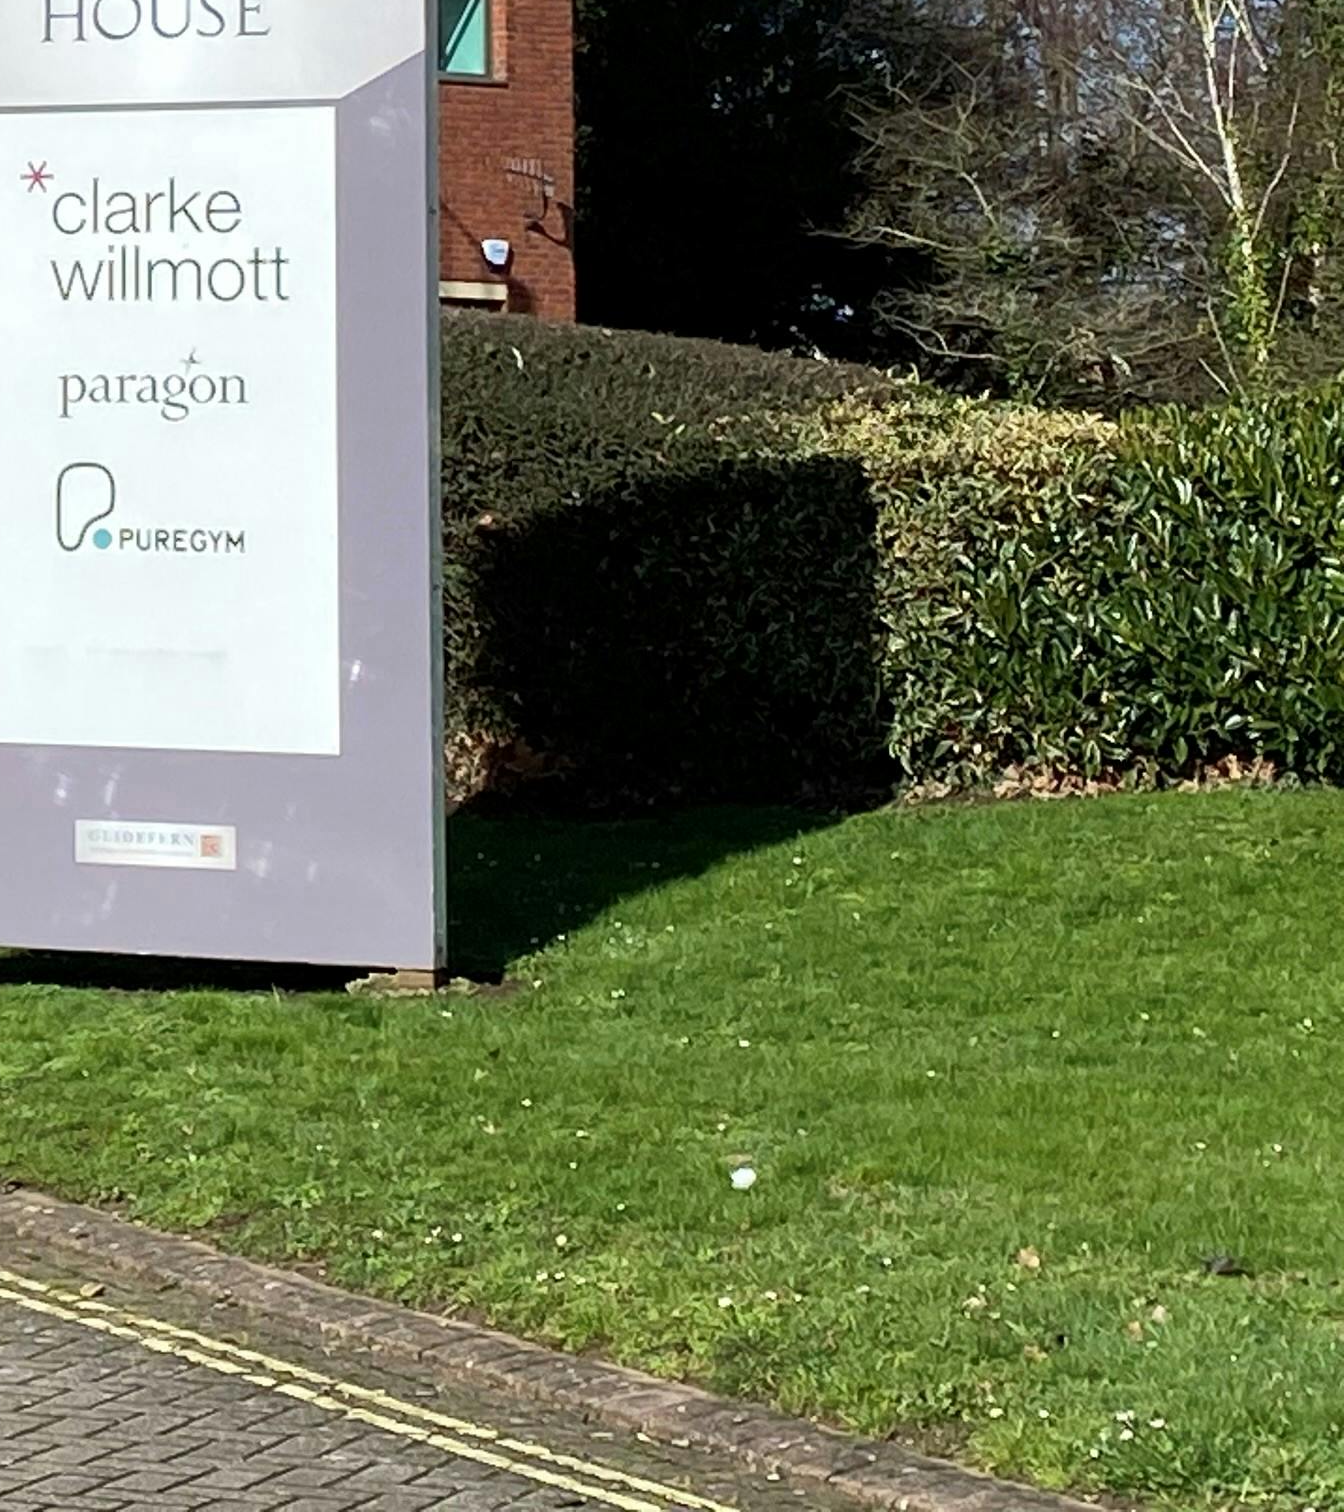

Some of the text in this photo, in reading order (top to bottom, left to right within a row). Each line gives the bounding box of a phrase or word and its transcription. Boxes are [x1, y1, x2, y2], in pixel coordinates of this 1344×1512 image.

[51, 177, 242, 235] clarke
[49, 245, 291, 302] willmott
[57, 370, 250, 422] paragon
[118, 528, 246, 554] PUREGYM
